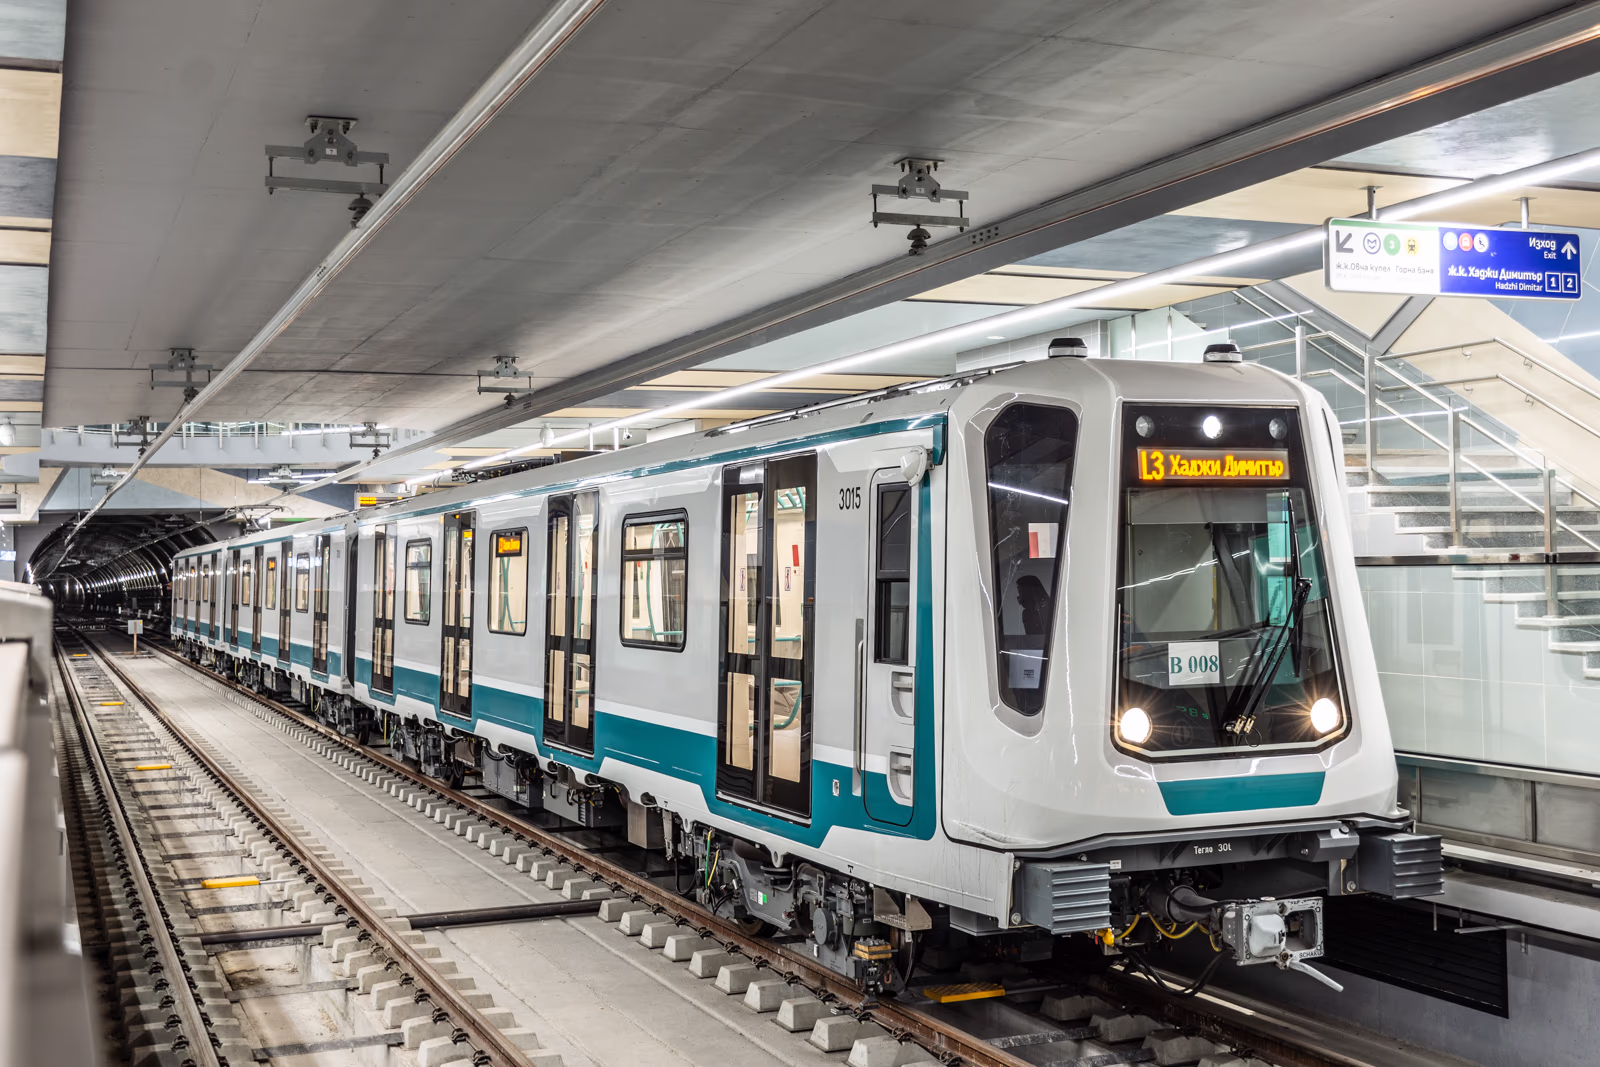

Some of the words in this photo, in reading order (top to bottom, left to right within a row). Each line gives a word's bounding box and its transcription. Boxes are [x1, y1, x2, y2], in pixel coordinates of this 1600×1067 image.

[1389, 240, 1395, 250] 3
[1529, 237, 1556, 250] Изход
[1544, 251, 1556, 259] Exit
[1370, 264, 1391, 273] купел
[1396, 266, 1415, 274] Горна
[1468, 267, 1498, 280] Хаджи
[1499, 268, 1542, 282] Димитър
[1495, 282, 1518, 290] Hadzhi
[1519, 283, 1543, 291] Dimitar
[1550, 277, 1556, 287] 1
[1567, 278, 1573, 288] 2
[1141, 450, 1164, 480] L3
[1169, 455, 1221, 477] Хаджи
[1223, 455, 1284, 477] Димитър
[838, 486, 861, 510] 3015
[1188, 655, 1219, 673] 008
